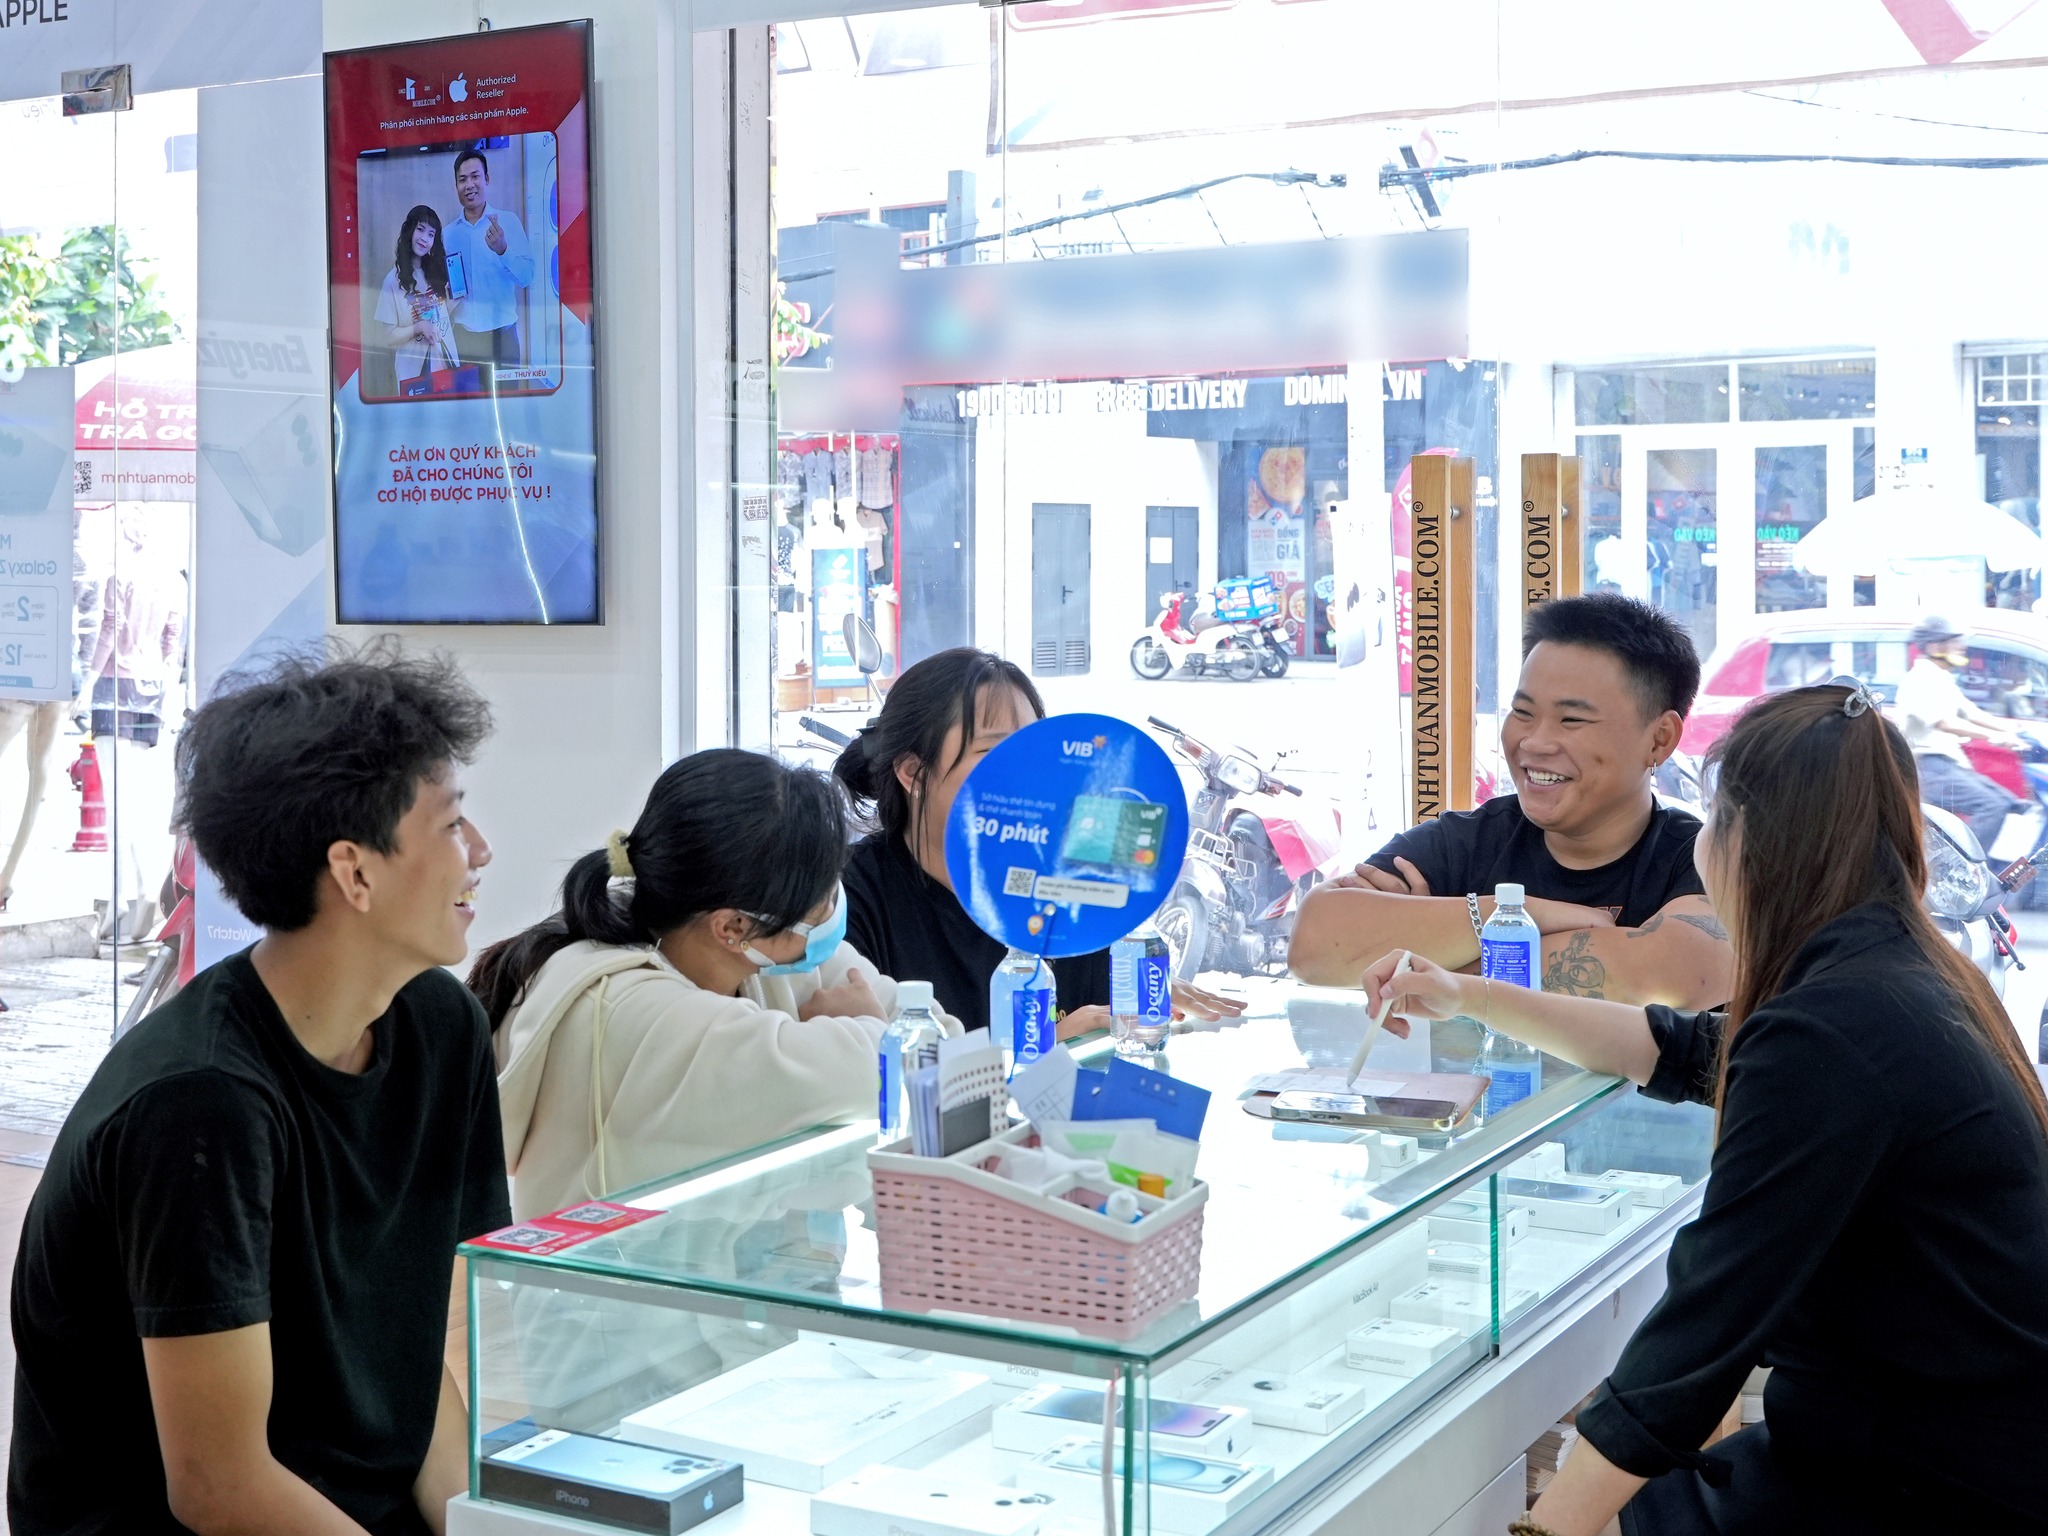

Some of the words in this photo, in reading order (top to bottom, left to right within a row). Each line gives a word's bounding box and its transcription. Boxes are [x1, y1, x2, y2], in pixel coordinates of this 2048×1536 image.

[476, 74, 516, 87] Authorized
[476, 89, 505, 99] Reseller
[1151, 379, 1248, 411] DELIVERY
[94, 398, 148, 419] HỖ
[156, 404, 196, 420] TR
[79, 421, 148, 440] TRẢ
[389, 445, 420, 463] CẢM
[424, 447, 446, 461] ƠN
[450, 443, 480, 462] QUÝ
[484, 443, 537, 460] KHÁCH
[101, 470, 196, 485] mnhtuanmob
[393, 466, 414, 483] ĐÃ
[417, 468, 449, 482] CHO
[452, 464, 505, 481] CHÚNG
[509, 465, 533, 479] TÔI
[377, 487, 398, 503] CƠ
[401, 486, 427, 505] HỘI
[430, 485, 473, 505] ĐƯỢC
[477, 486, 518, 505] PHỤC
[521, 485, 543, 502] VỤ
[1062, 739, 1094, 758] VIB
[974, 816, 999, 837] 30
[999, 821, 1050, 845] phút
[1482, 942, 1491, 978] cany
[1146, 961, 1163, 1023] Ocany
[1007, 1364, 1040, 1377] iPhone
[555, 1489, 590, 1507] iPhone
